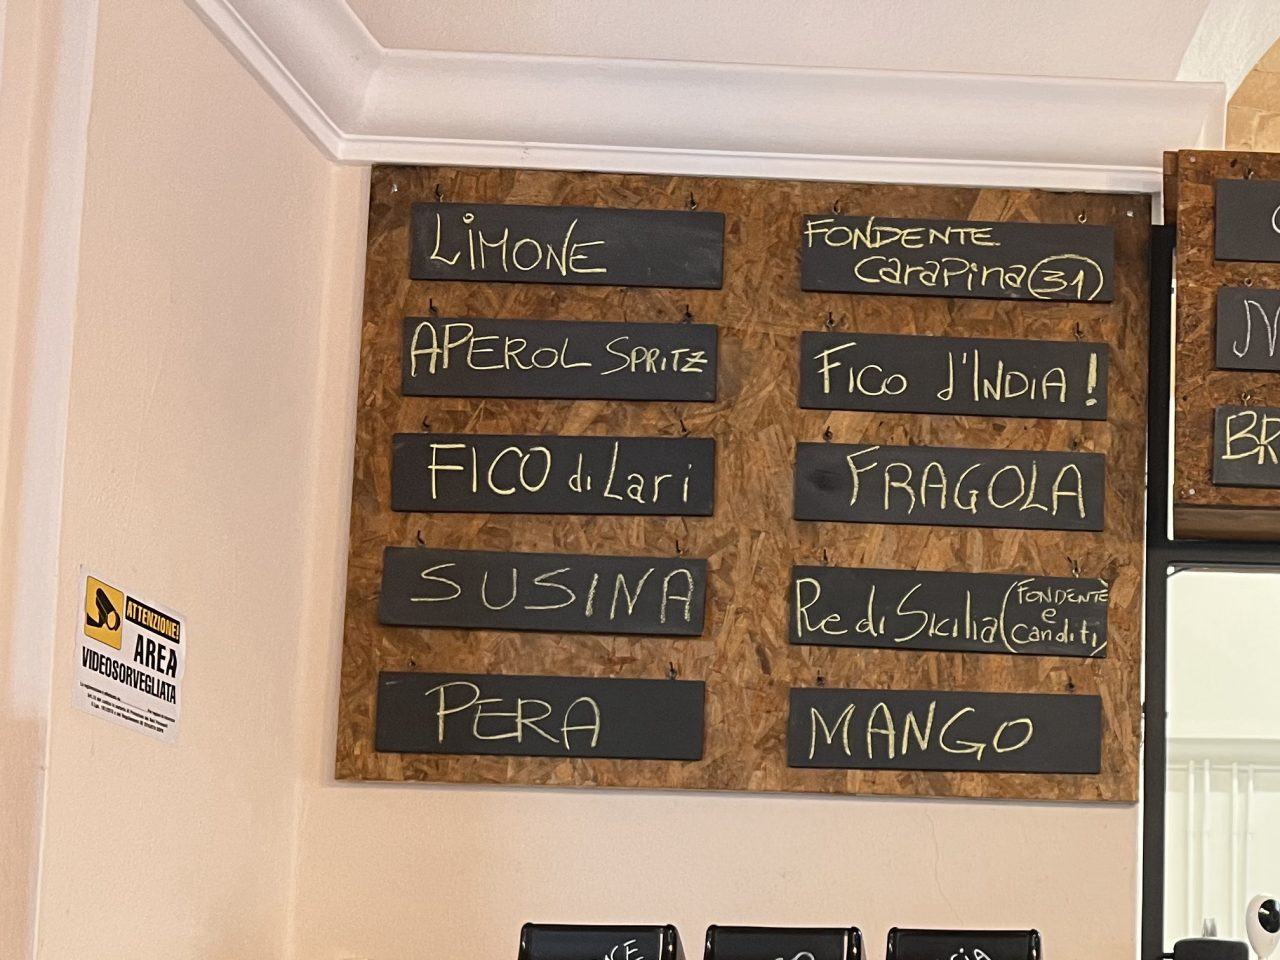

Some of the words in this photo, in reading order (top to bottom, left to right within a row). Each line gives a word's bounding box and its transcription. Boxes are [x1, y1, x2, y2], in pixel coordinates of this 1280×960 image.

[804, 215, 1000, 250] FONDENTE
[410, 321, 592, 377] APEROL
[427, 443, 552, 499] FICO
[566, 452, 594, 494] di
[603, 441, 693, 503] Lari
[846, 445, 1086, 519] FRAGOLA
[126, 599, 180, 641] ATTENZIONE!
[410, 563, 694, 624] SUSINA
[794, 575, 849, 640] Re
[81, 645, 177, 705] VIDEOSORVEGLIATA
[133, 633, 178, 679] AREA
[424, 681, 600, 750] PERA
[808, 700, 1033, 761] MANGO
